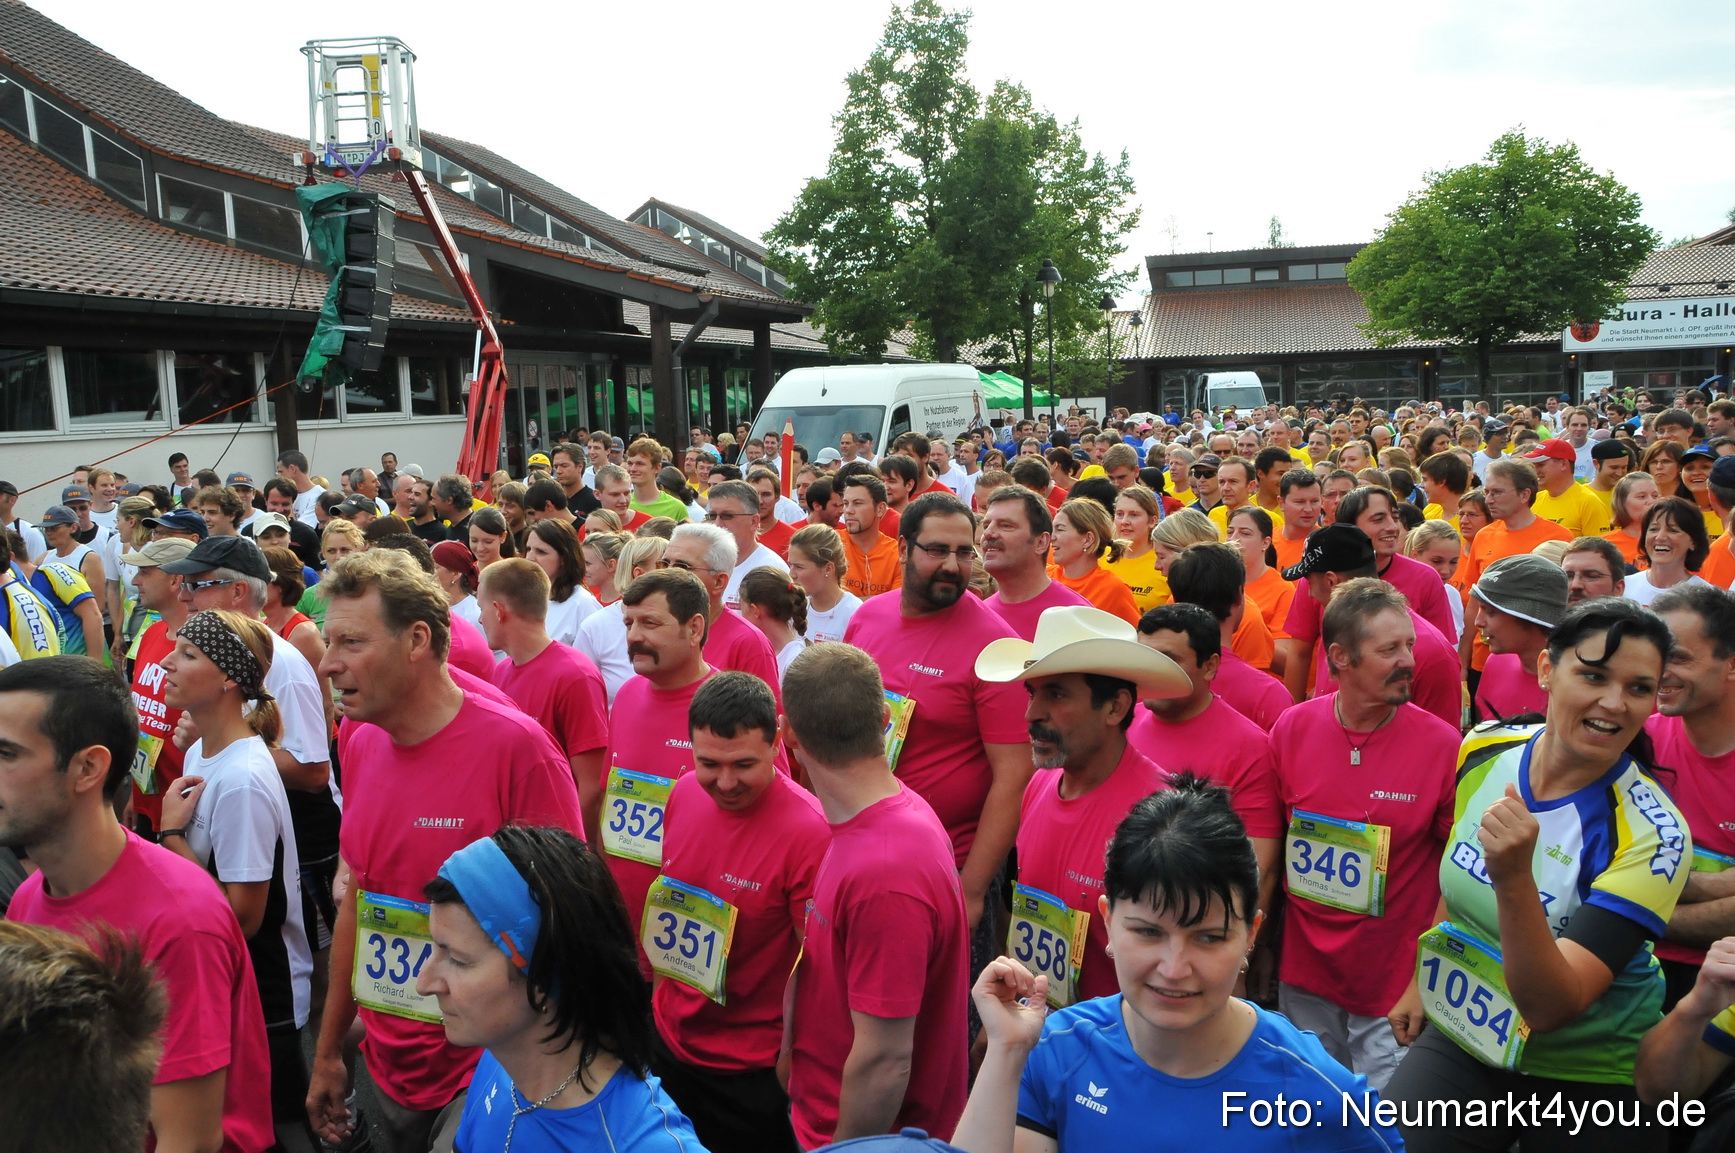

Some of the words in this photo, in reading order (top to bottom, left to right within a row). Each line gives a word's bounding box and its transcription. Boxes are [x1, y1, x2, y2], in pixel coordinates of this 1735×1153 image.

[1684, 331, 1728, 339] angenehmen
[1703, 324, 1723, 332] grüßt
[926, 420, 941, 430] Partner
[953, 417, 966, 427] Region
[14, 593, 49, 652] BOCK
[146, 716, 172, 732] Team
[1378, 790, 1418, 802] DAHMIT
[421, 817, 465, 828] DAHMIT
[608, 798, 665, 843] 352
[618, 835, 633, 845] Paul
[1628, 780, 1685, 884] BOCK
[1291, 838, 1362, 889] 346
[726, 874, 762, 891] DAHMIT
[1069, 869, 1104, 889] DAHMIT
[1298, 874, 1329, 892] Thomas
[653, 911, 716, 969] 351
[1014, 920, 1066, 982] 358
[662, 952, 697, 972] Andreas
[373, 981, 406, 998] Richard
[1422, 956, 1513, 1048] 1054
[1434, 1000, 1466, 1032] Claudia
[1075, 1093, 1108, 1115] erima
